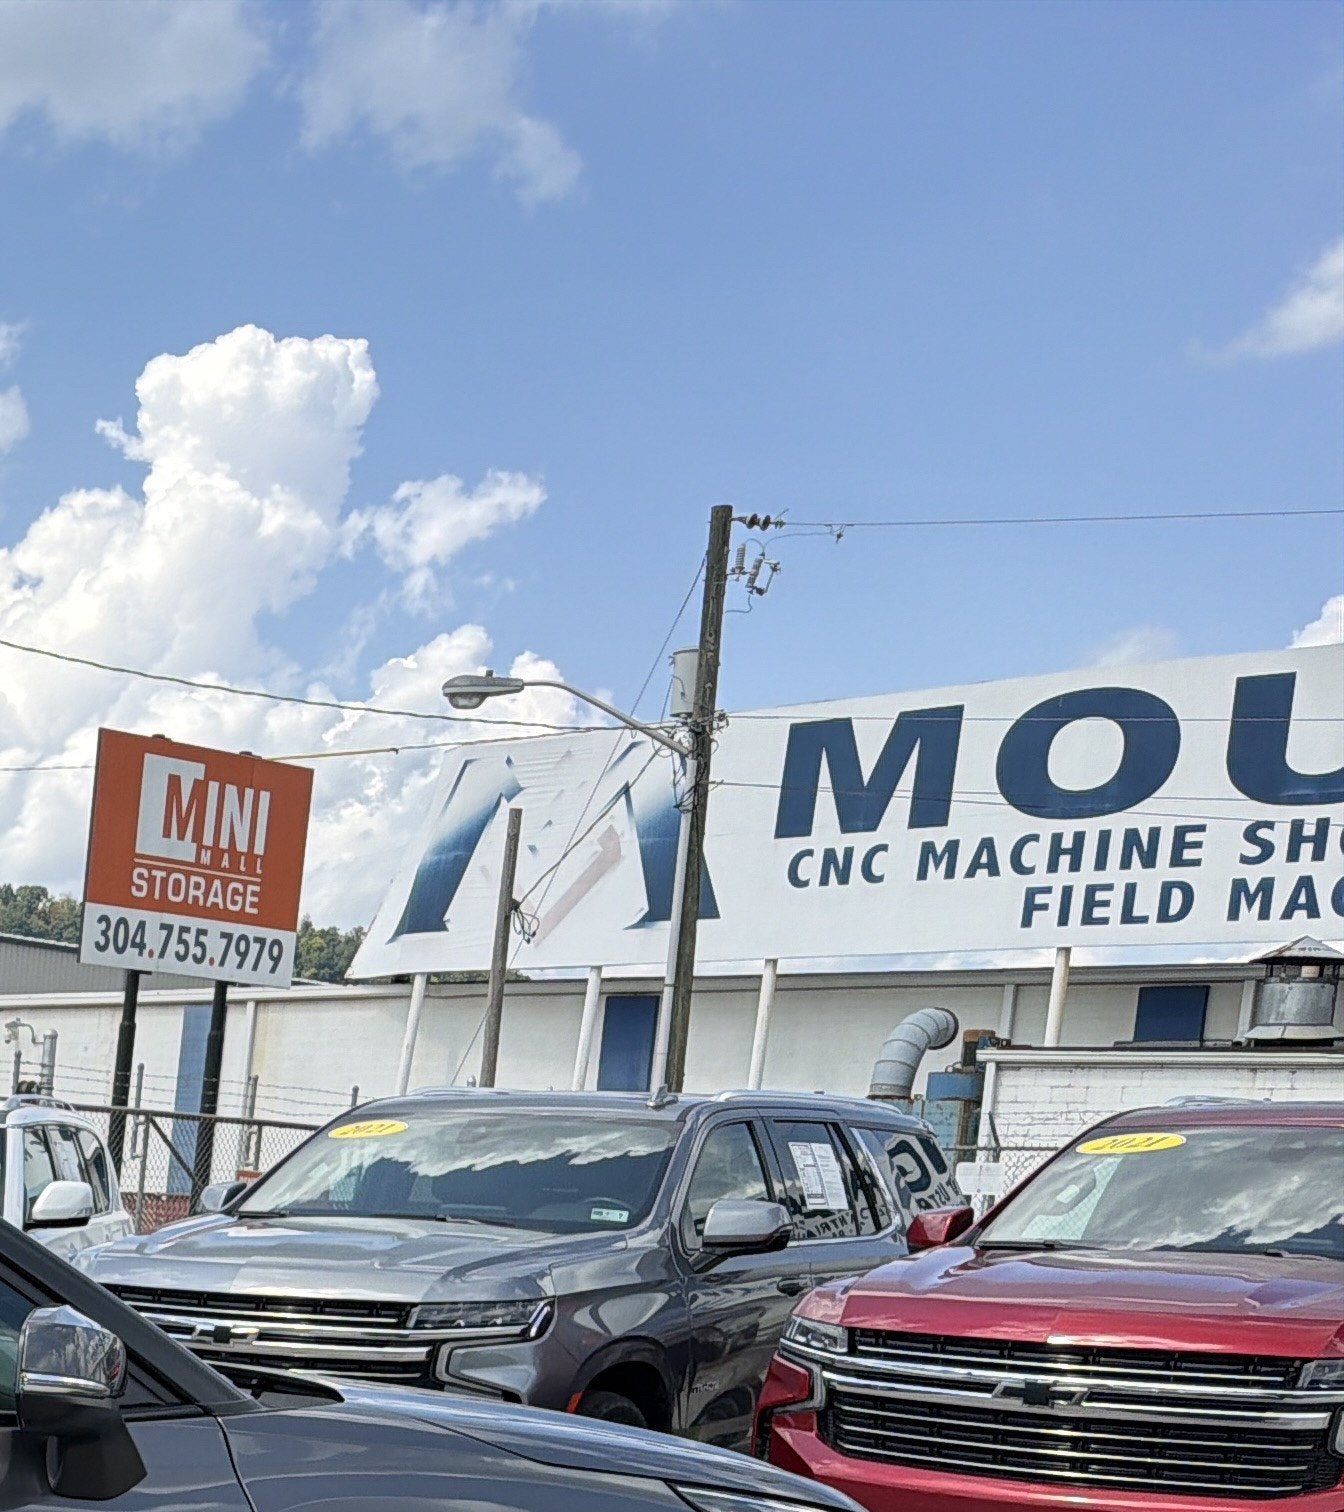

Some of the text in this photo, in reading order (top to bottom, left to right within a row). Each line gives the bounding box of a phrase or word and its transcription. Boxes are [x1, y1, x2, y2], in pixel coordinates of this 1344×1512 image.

[200, 848, 263, 875] MALL
[787, 816, 1344, 889] CNC MACHINE SH
[130, 866, 261, 915] STORAGE
[1020, 880, 1195, 929] FIELD
[94, 914, 284, 974] 304.755.7979
